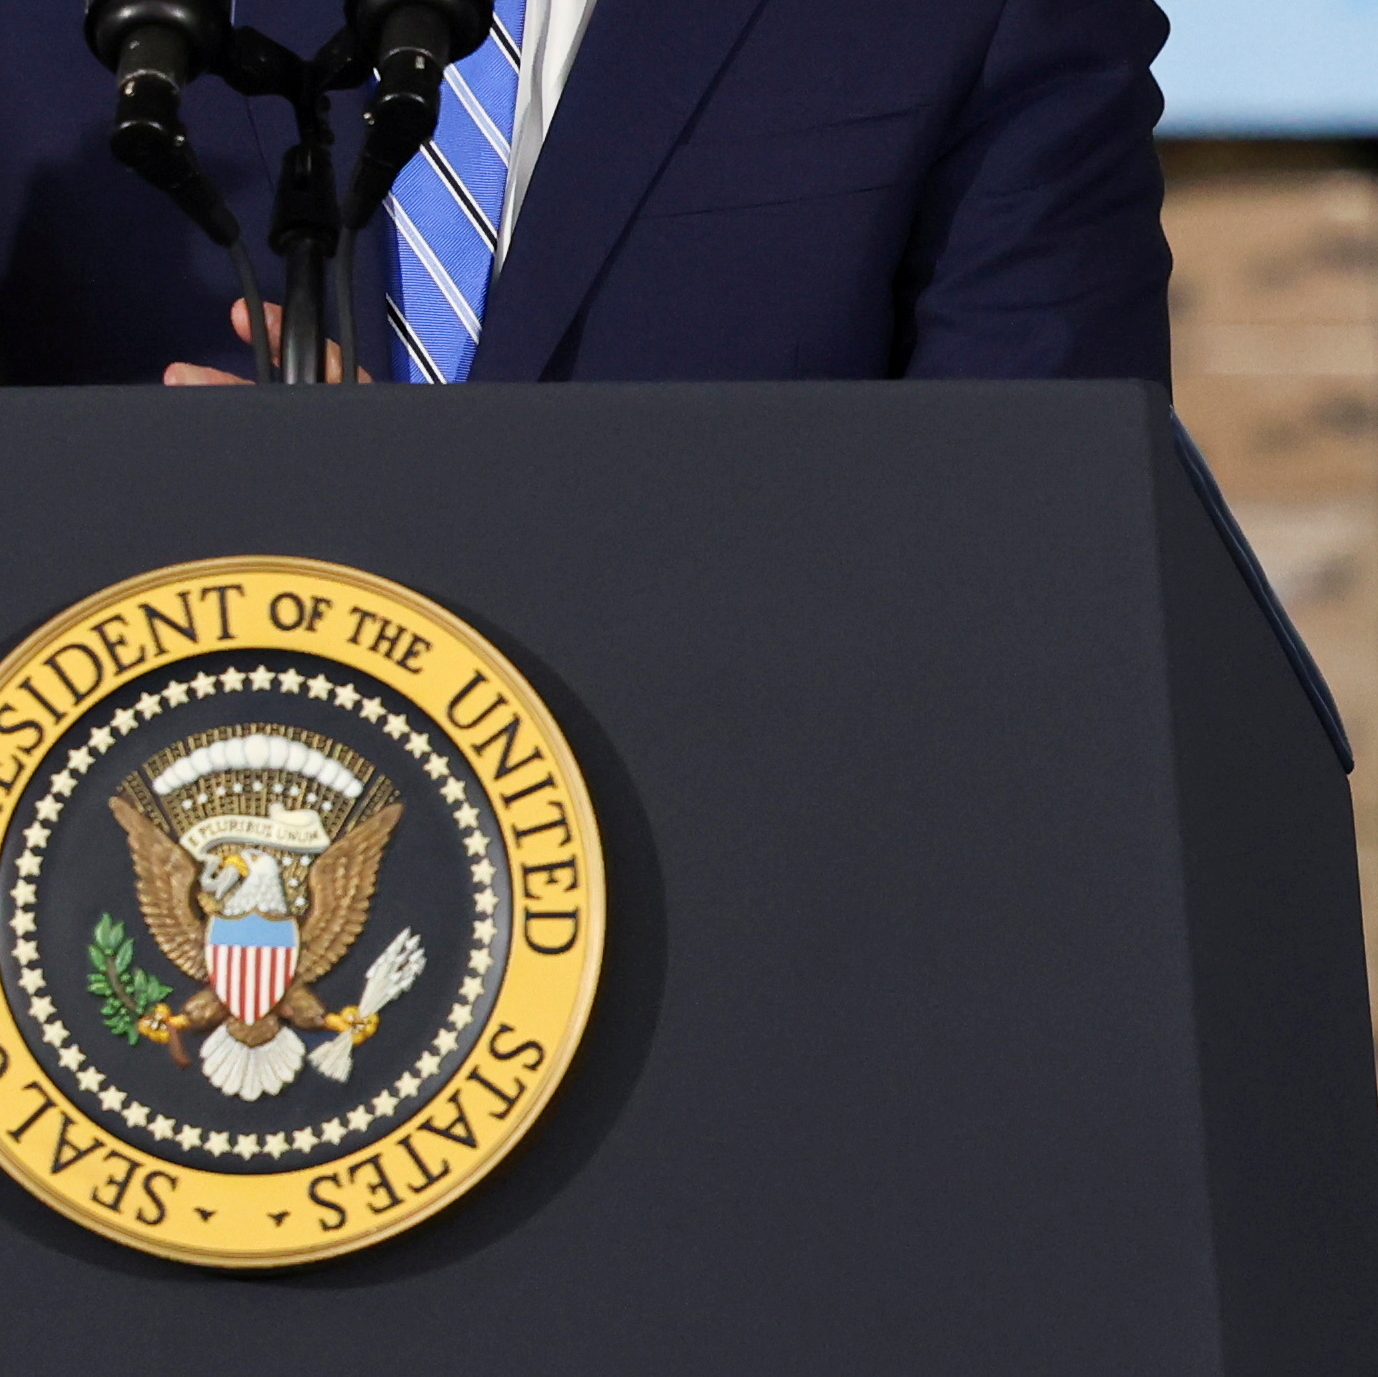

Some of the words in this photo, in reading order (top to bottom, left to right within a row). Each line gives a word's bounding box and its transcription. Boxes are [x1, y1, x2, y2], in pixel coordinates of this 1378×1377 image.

[270, 592, 332, 631] OF
[347, 606, 433, 675] THE
[445, 668, 580, 956] UNITED
[7, 1081, 179, 1226] SEAL
[307, 1023, 545, 1232] STATES
